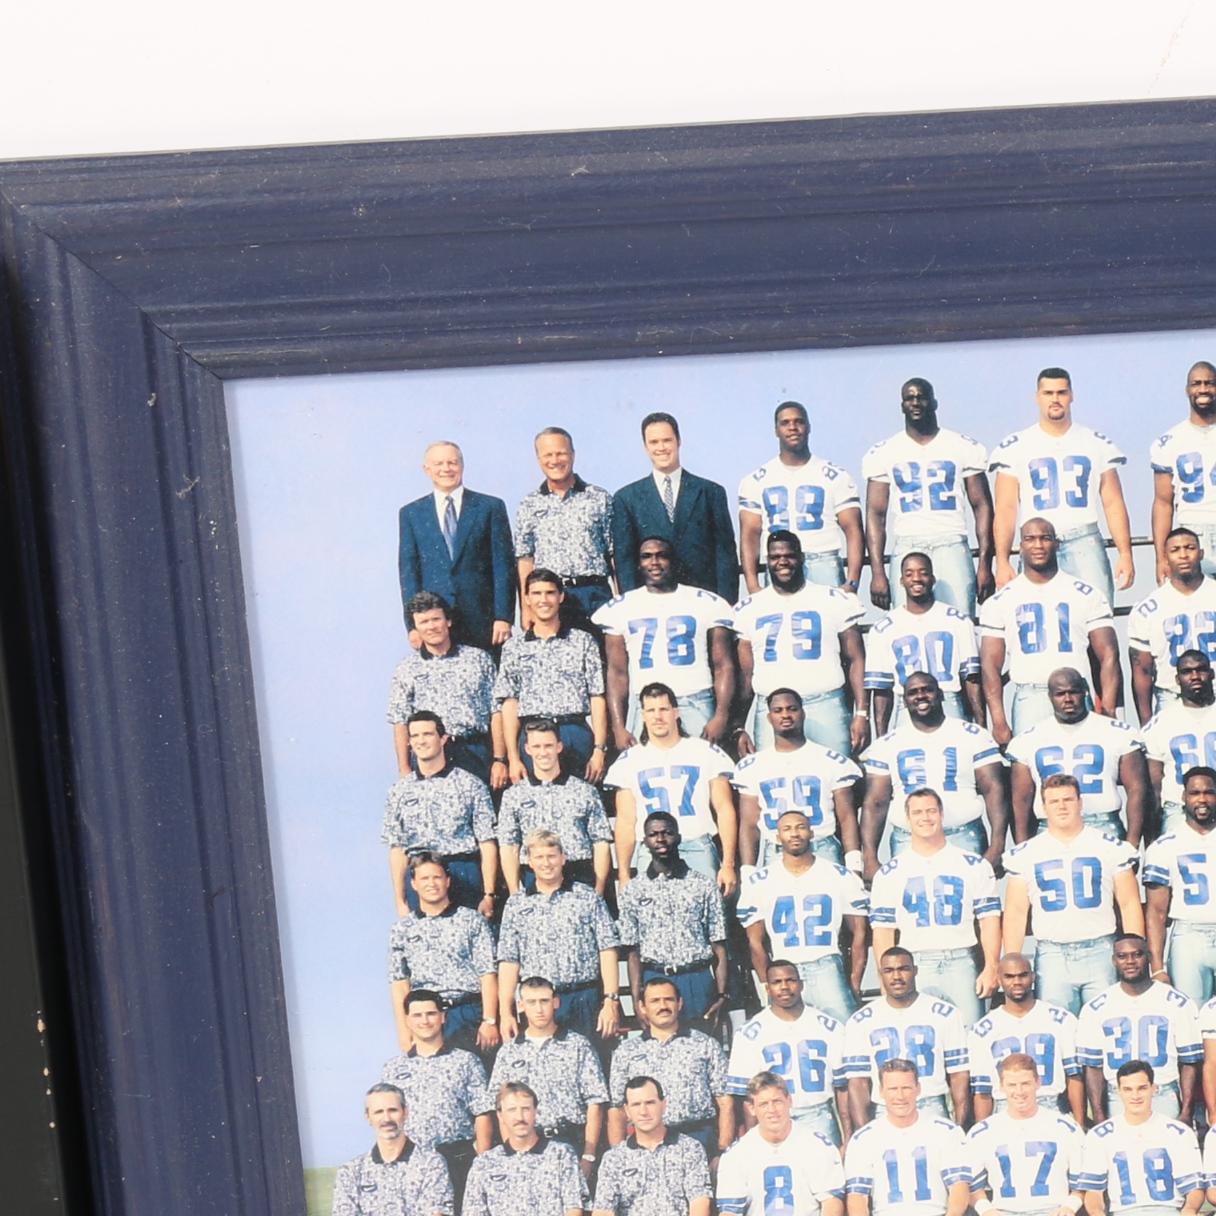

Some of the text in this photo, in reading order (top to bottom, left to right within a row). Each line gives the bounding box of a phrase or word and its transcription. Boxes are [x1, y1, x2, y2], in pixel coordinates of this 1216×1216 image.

[893, 460, 958, 513] 92
[1030, 455, 1093, 511] 93
[629, 615, 698, 670] 78
[756, 610, 823, 663] 79
[1019, 602, 1073, 655] 81
[639, 765, 701, 817] 57
[903, 874, 965, 928] 48
[1034, 856, 1103, 913] 50
[772, 894, 833, 948] 42
[1103, 1017, 1169, 1071] 30
[763, 1165, 795, 1216] 8
[883, 1148, 934, 1203] 11
[998, 1142, 1058, 1199] 17
[1112, 1148, 1174, 1205] 18
